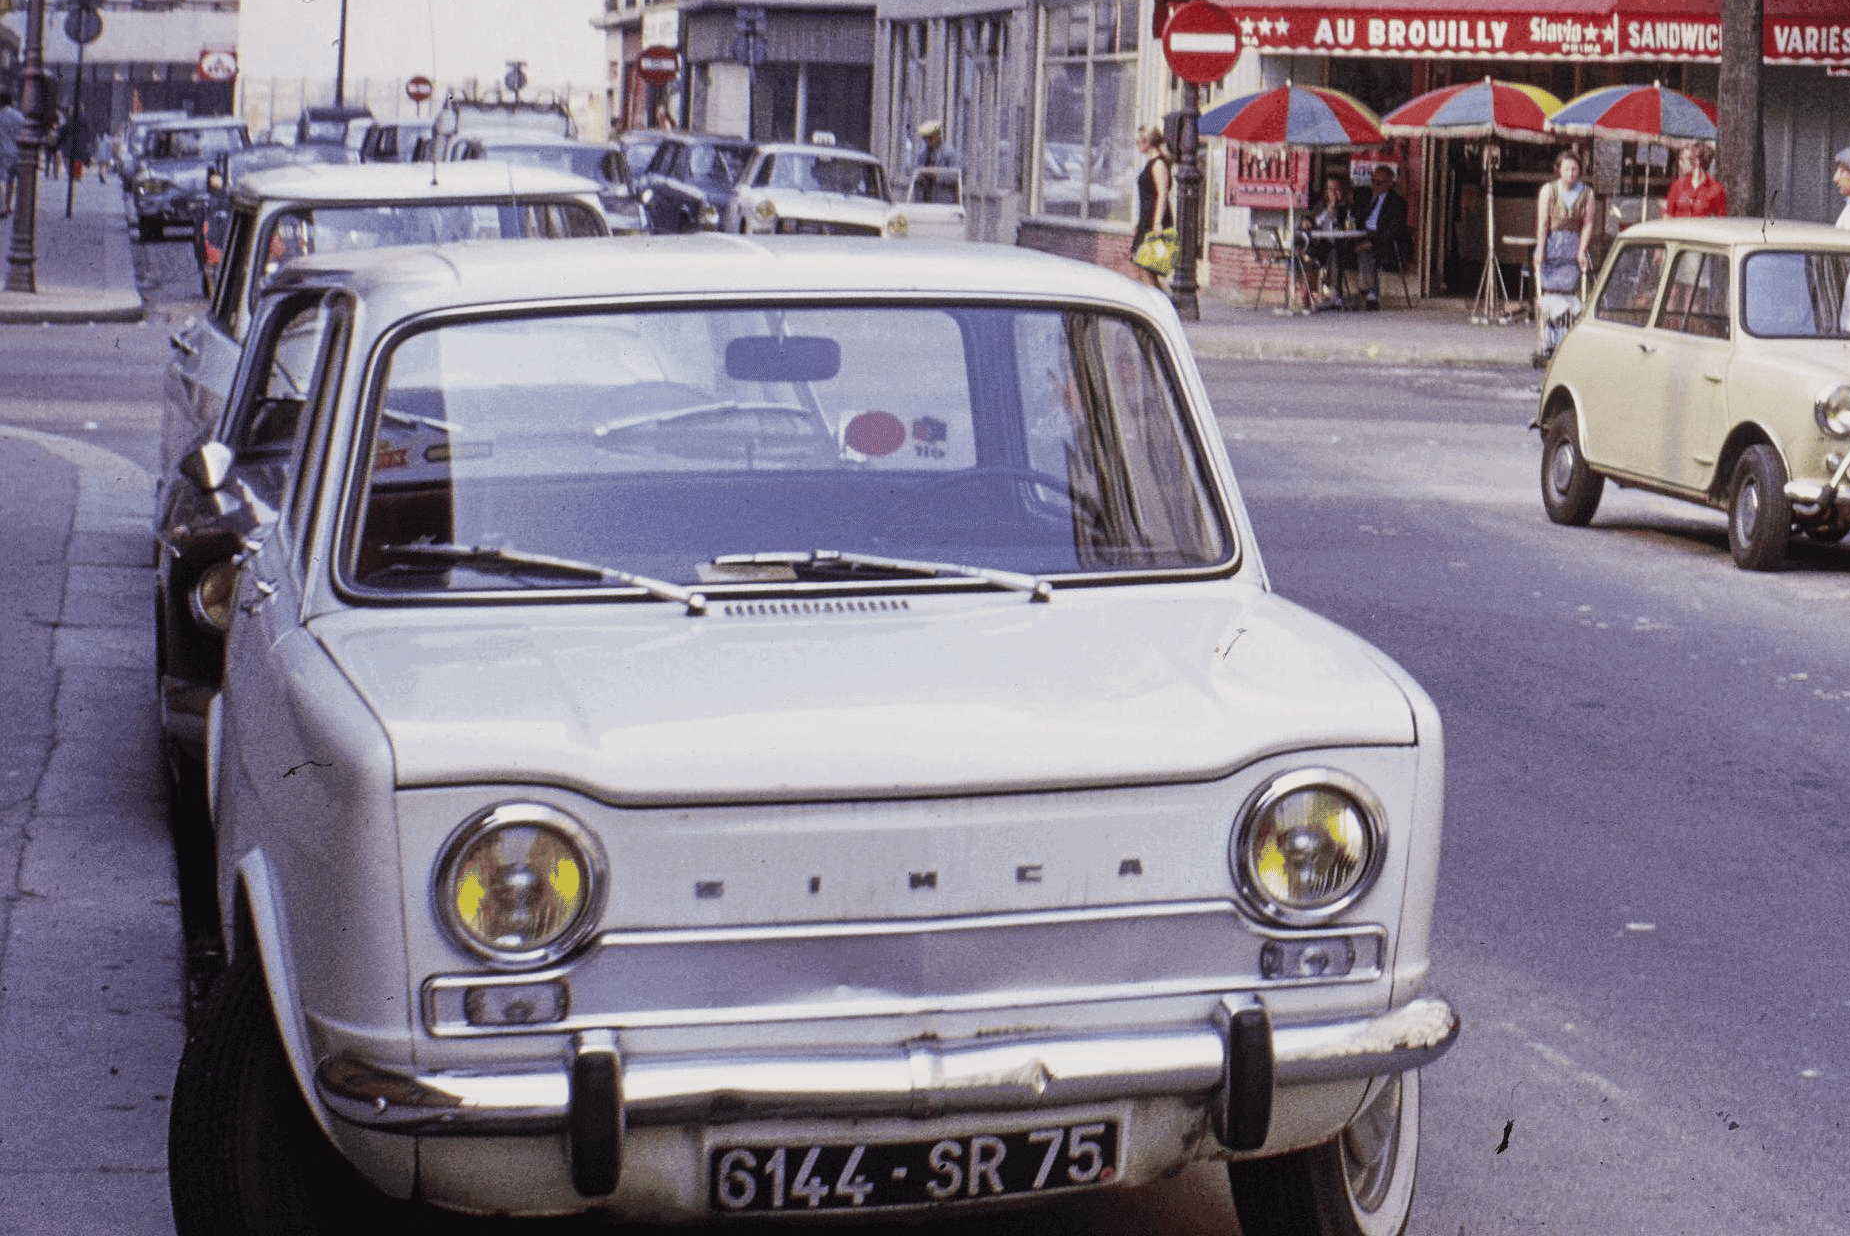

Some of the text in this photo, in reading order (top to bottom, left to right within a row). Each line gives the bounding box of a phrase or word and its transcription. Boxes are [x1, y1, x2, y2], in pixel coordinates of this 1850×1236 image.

[1313, 18, 1508, 48] AU BROUILLY
[1627, 21, 1722, 51] SANDWIC
[718, 1146, 874, 1209] 6144
[1028, 1124, 1106, 1189] 75
